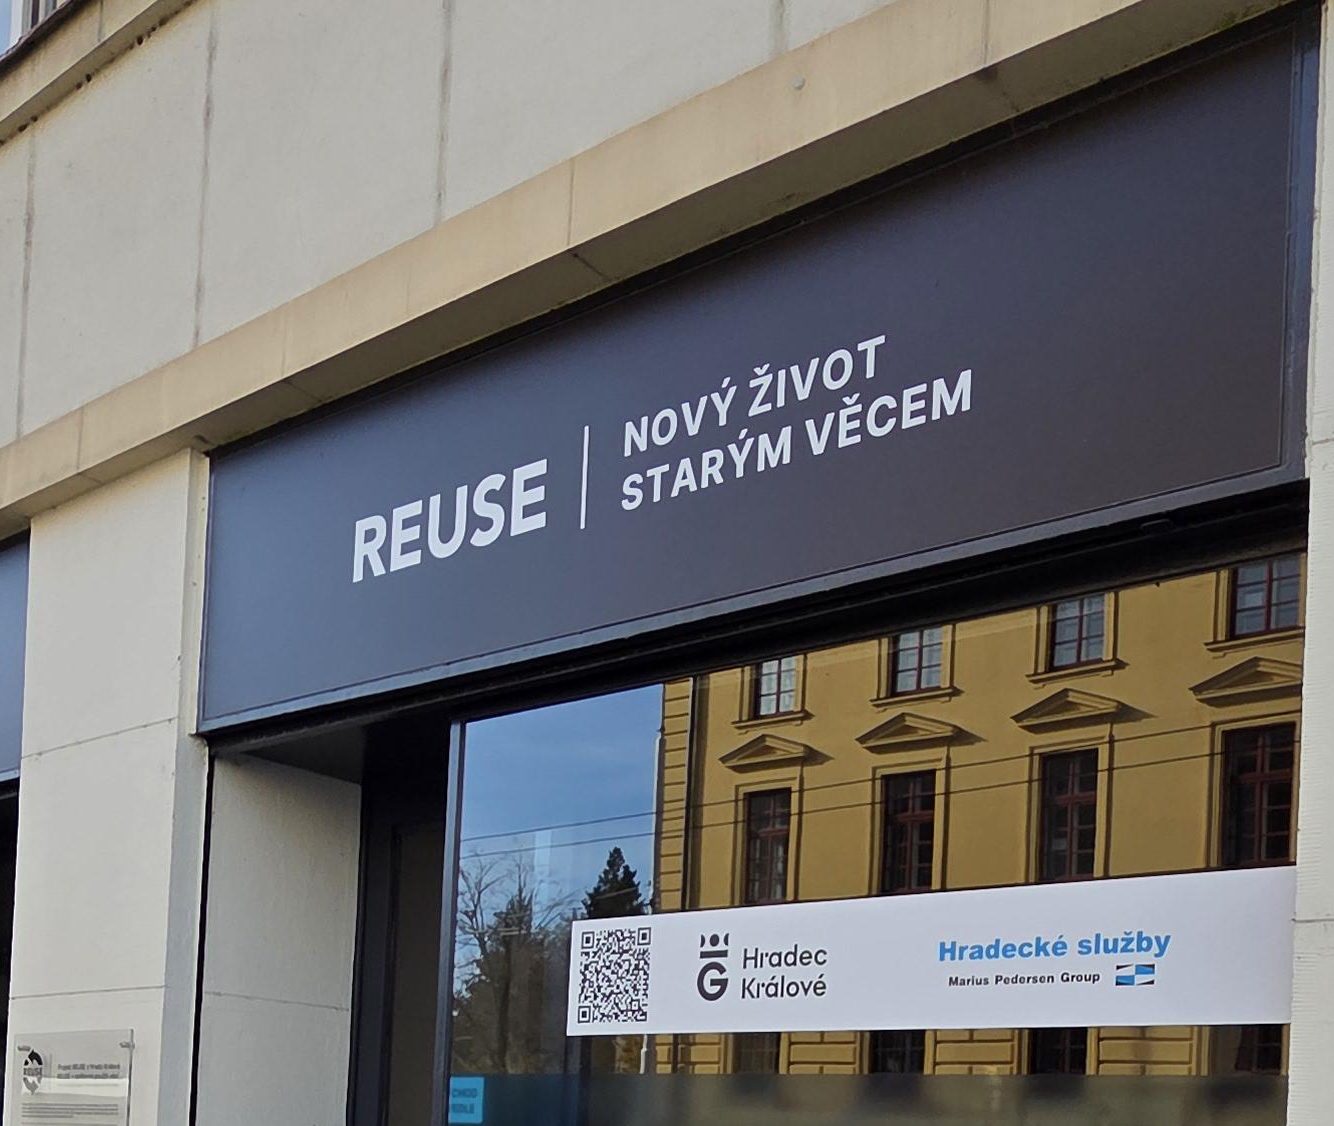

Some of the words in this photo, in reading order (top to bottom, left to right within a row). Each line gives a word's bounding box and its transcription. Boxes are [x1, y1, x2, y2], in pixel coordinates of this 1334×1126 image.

[623, 376, 737, 458] NOVÝ
[747, 334, 886, 417] ŽIVOT
[621, 425, 792, 511] STARÝM
[804, 369, 972, 456] VĚCEM
[352, 458, 548, 584] REUSE
[742, 944, 828, 969] Hradec
[939, 934, 1068, 962] Hradecké
[1077, 930, 1172, 958] služby
[741, 973, 827, 1000] Králové
[948, 975, 990, 987] Marius
[994, 973, 1055, 986] Pedersen
[1060, 972, 1101, 985] Group
